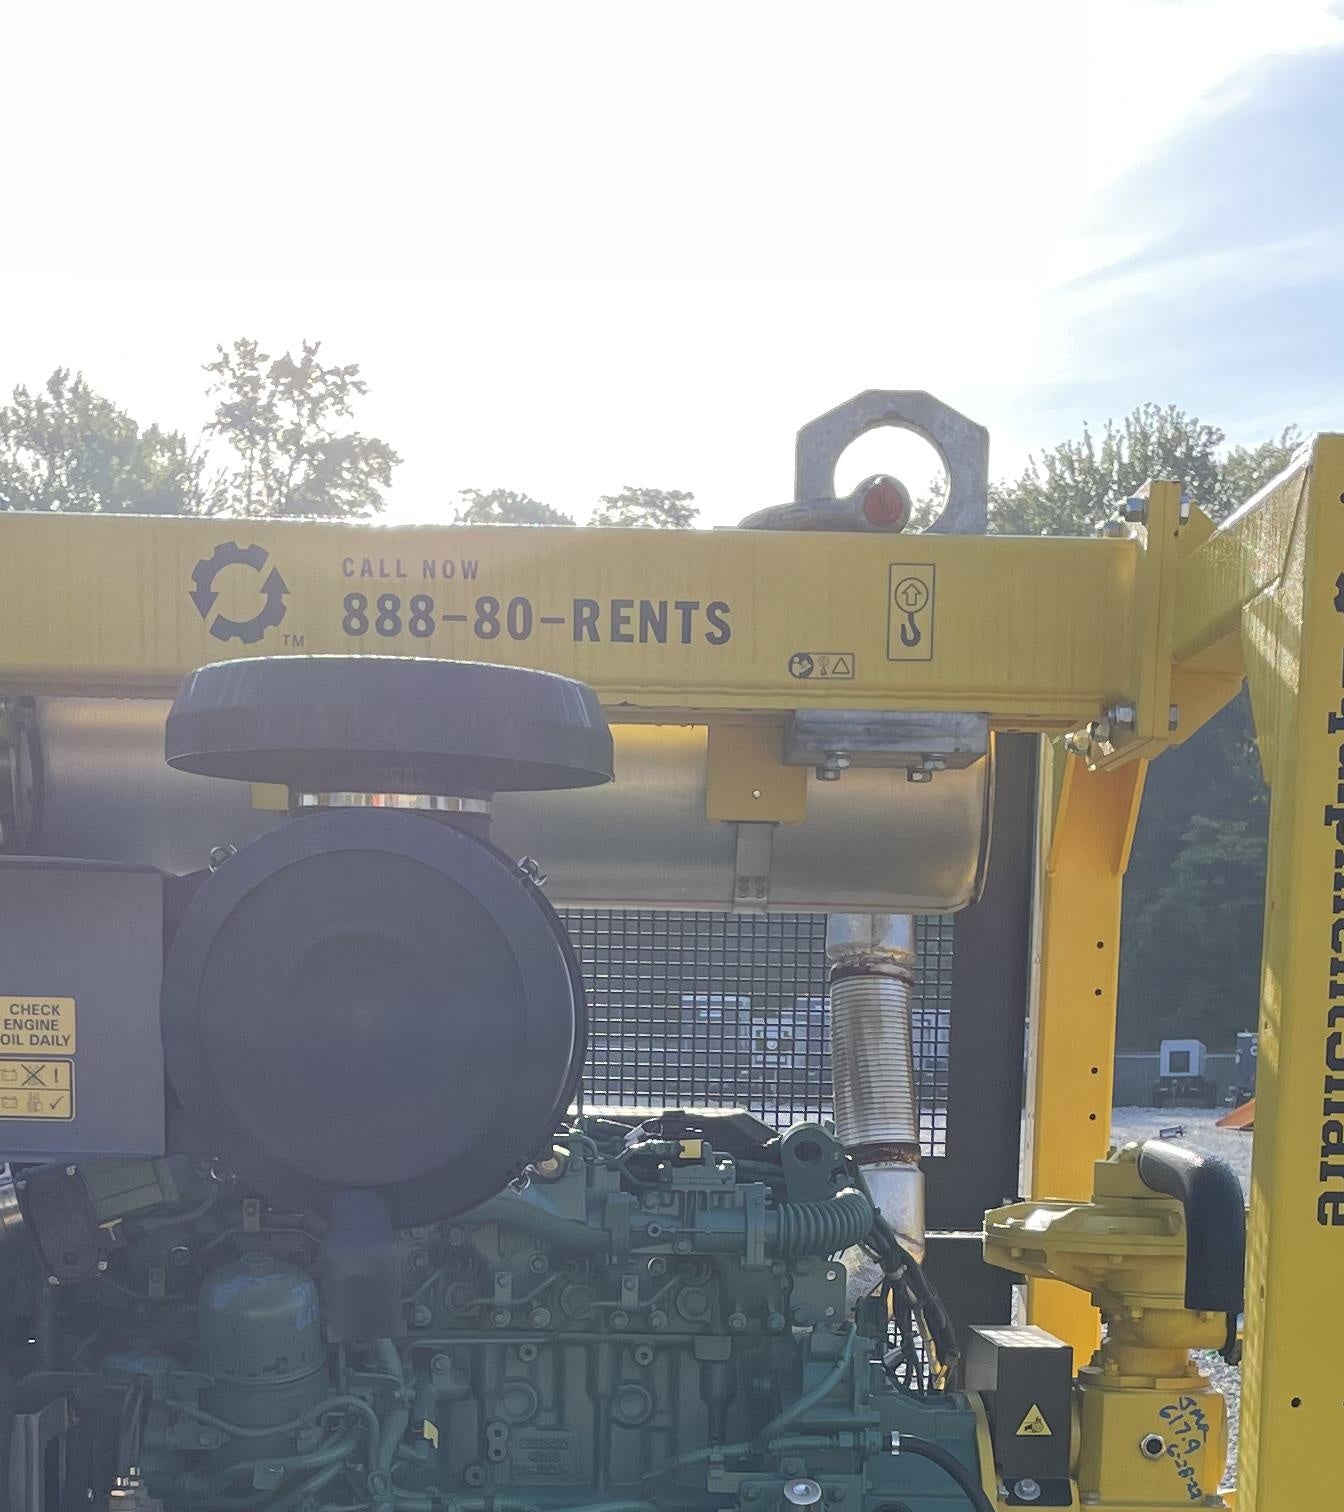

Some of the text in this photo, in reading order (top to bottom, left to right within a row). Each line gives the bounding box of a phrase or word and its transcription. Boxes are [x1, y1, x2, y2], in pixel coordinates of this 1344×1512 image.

[341, 557, 481, 581] CALL NOW
[341, 592, 732, 645] 888-80-RENTS
[282, 634, 305, 648] TM
[9, 1003, 61, 1016] CHECK
[3, 1018, 59, 1031] ENGINE
[0, 1033, 71, 1047] OIL DAILY
